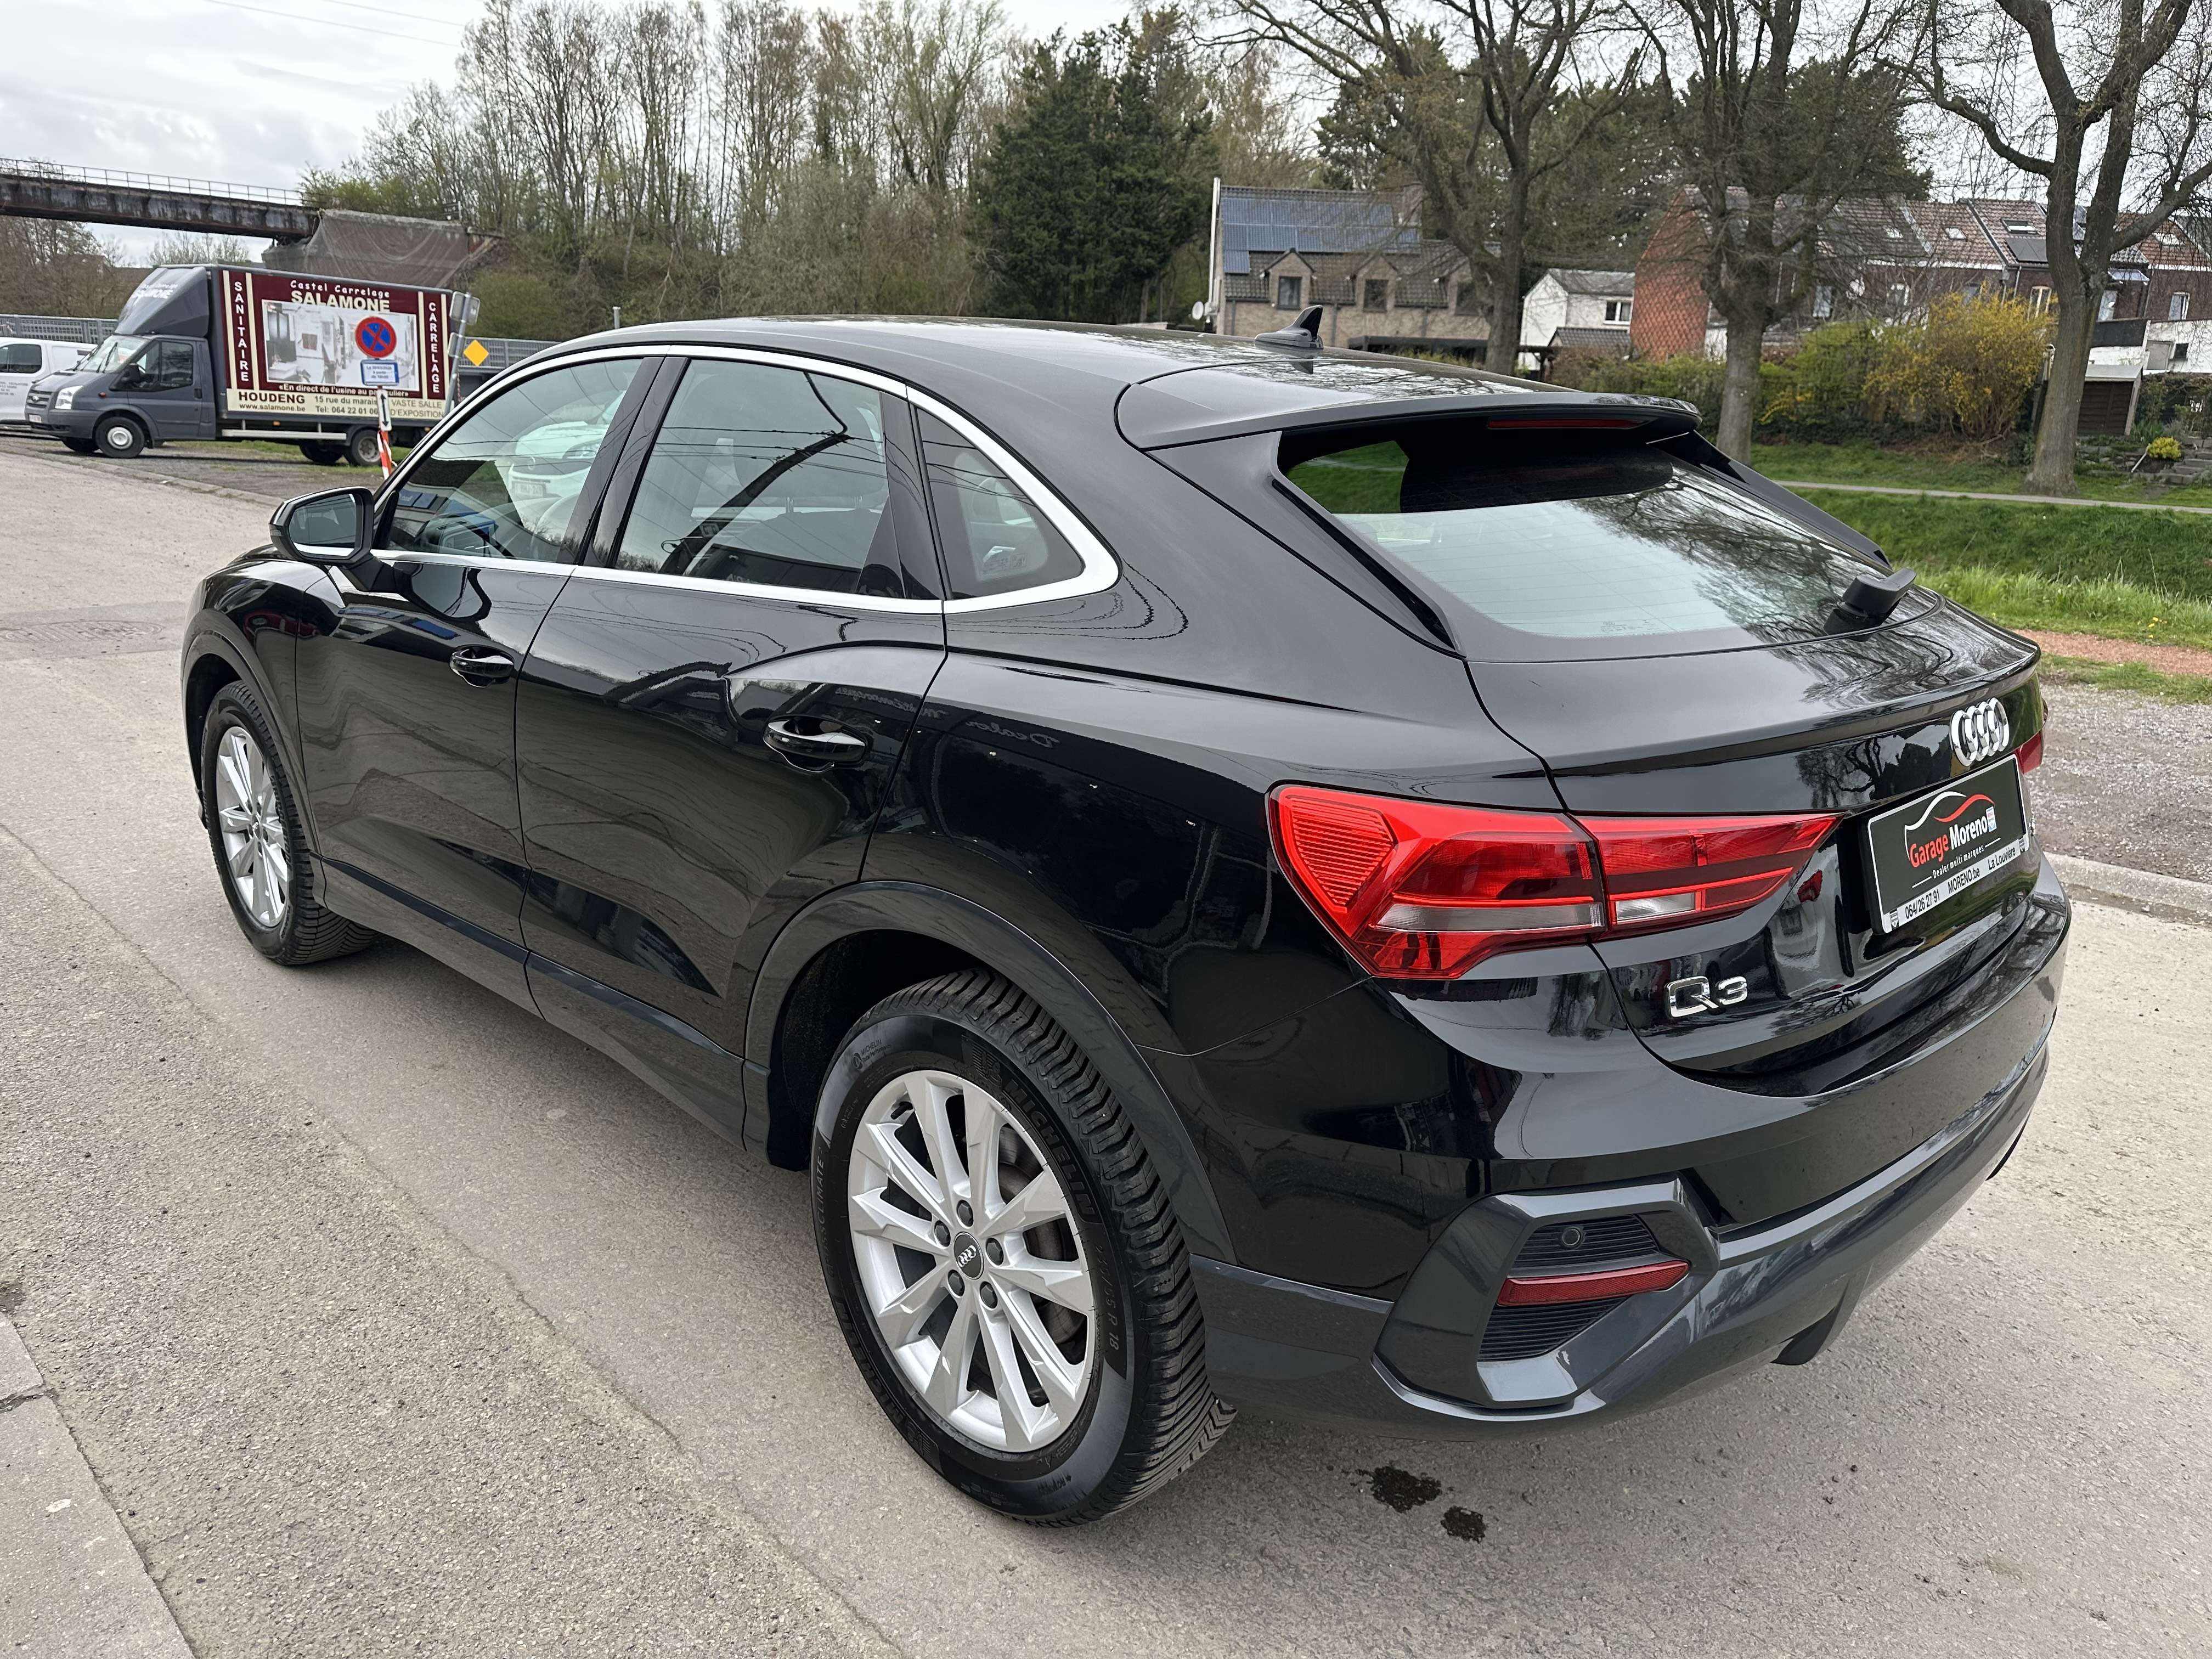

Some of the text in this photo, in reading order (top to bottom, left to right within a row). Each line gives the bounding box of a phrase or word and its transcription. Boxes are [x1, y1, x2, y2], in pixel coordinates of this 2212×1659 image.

[290, 280, 390, 299] Castel Carrelage
[291, 290, 391, 312] SALAMONE
[234, 281, 249, 382] SANITAIRE
[428, 302, 440, 393] CARRELAGE
[239, 392, 305, 404] HOUDENG
[296, 385, 319, 393] direct
[320, 386, 330, 394] de
[239, 403, 306, 411] www.salamone.be
[391, 409, 444, 418] D'EXPOSITION
[392, 399, 442, 409] VASTE SALLE
[1910, 816, 1988, 867] Garage Moreno
[1932, 844, 1985, 879] Dealer multi marques
[1905, 896, 1926, 919] 064/26
[1925, 893, 1933, 909] 27
[1933, 889, 1940, 903] 91
[1948, 867, 1980, 894] MORENO.be
[1988, 859, 1995, 870] La
[1995, 847, 2016, 866] Louvière
[1664, 975, 1748, 1017] Q3
[1002, 1078, 1096, 1215] MICHELIN
[1108, 1312, 1118, 1326] R
[1109, 1331, 1119, 1351] 18
